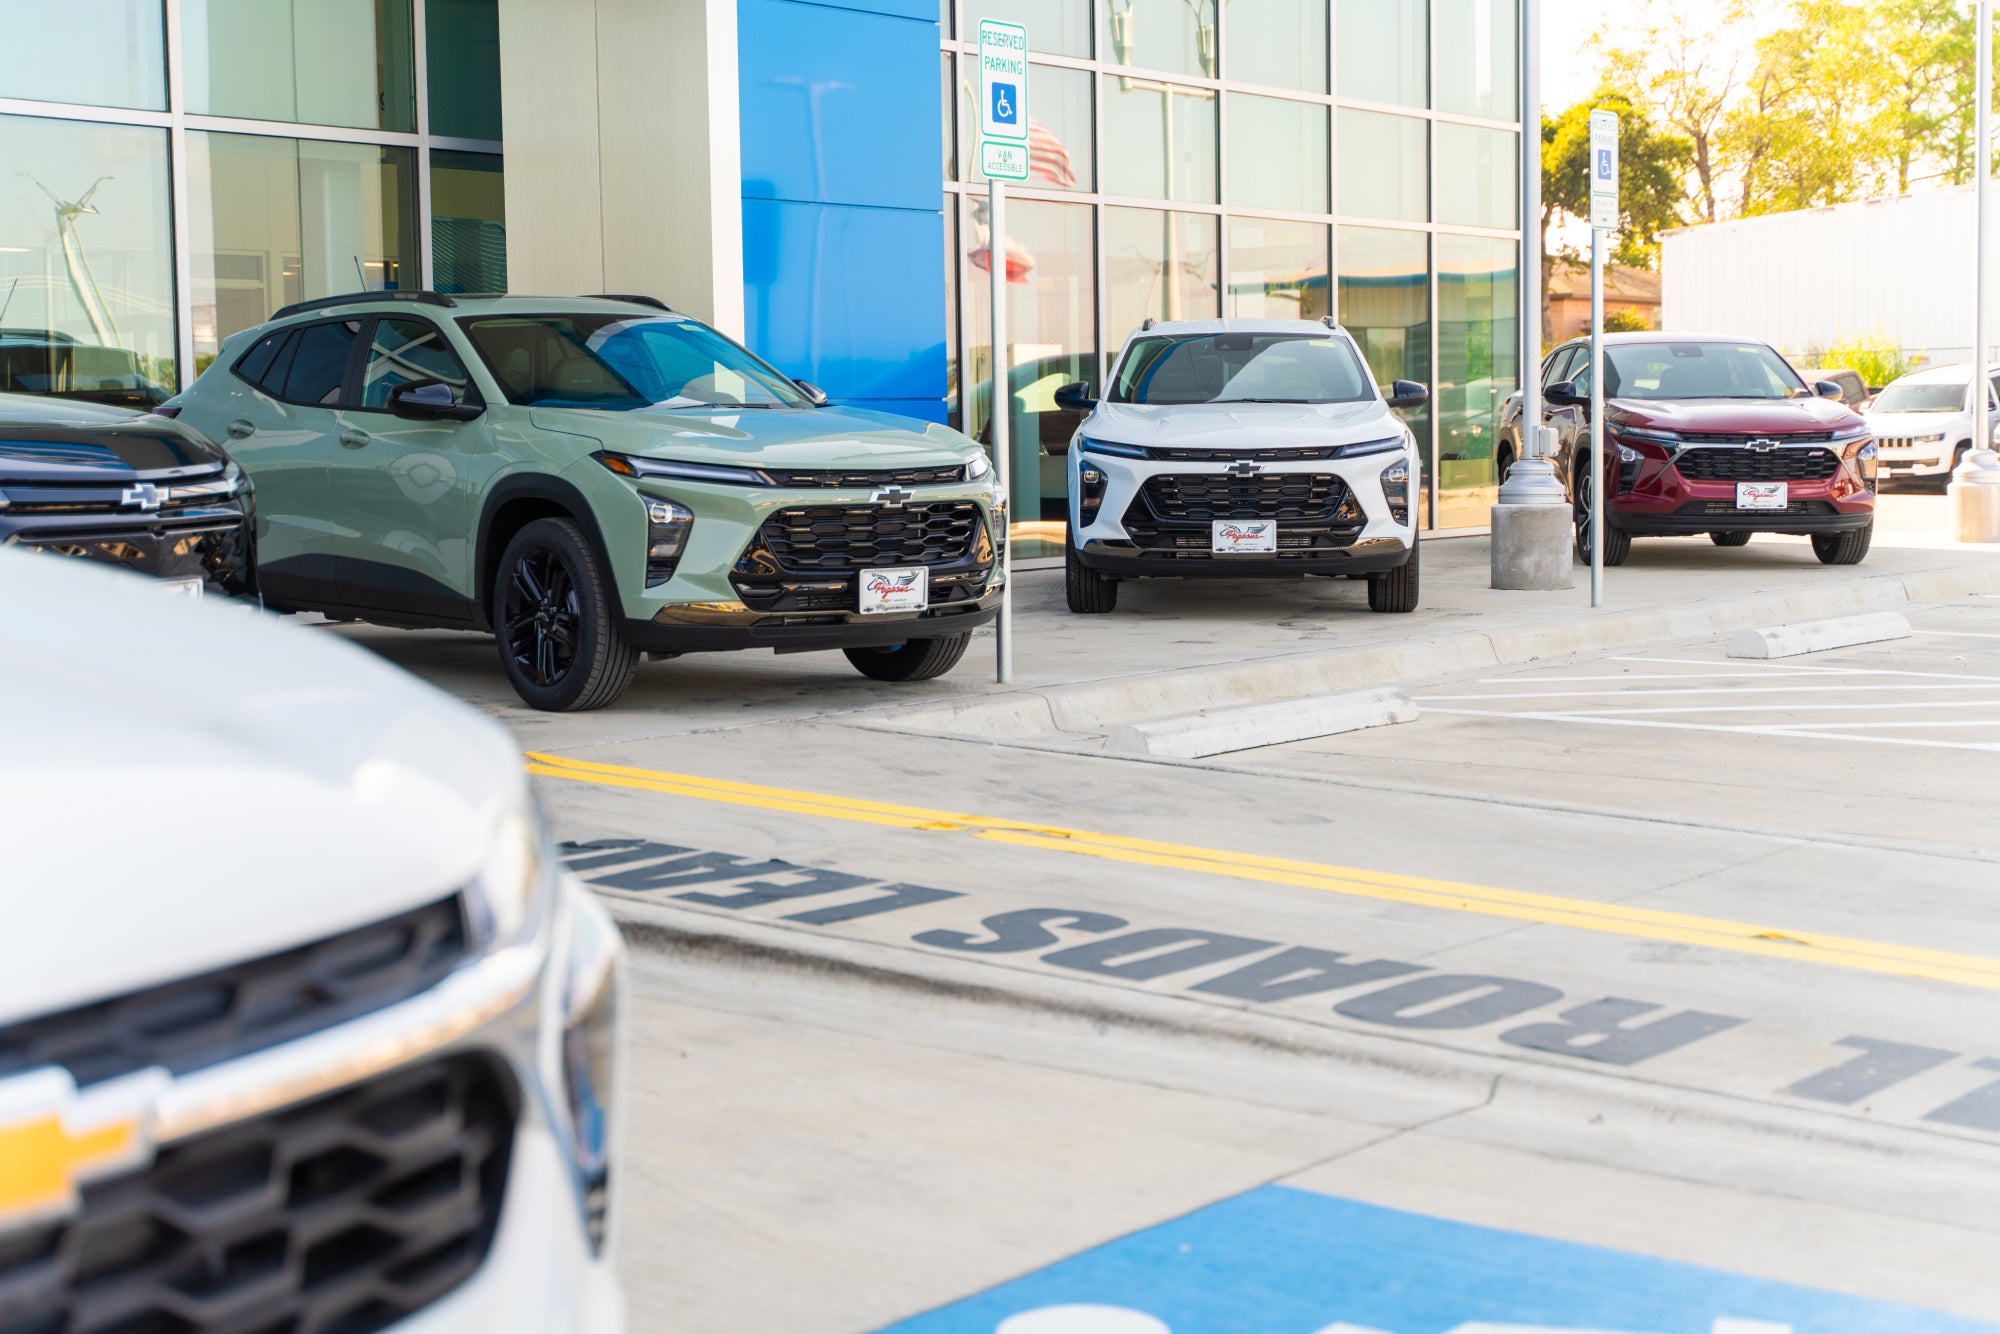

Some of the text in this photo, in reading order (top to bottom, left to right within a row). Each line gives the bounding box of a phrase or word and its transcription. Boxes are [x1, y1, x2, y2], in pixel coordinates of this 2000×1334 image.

[982, 30, 1024, 50] RESERVED
[984, 56, 1023, 75] PARKING
[997, 150, 1013, 161] VAN
[987, 161, 1023, 173] ACCESSIBLE
[873, 581, 916, 599] Pegasus
[912, 907, 1752, 1066] ROADS
